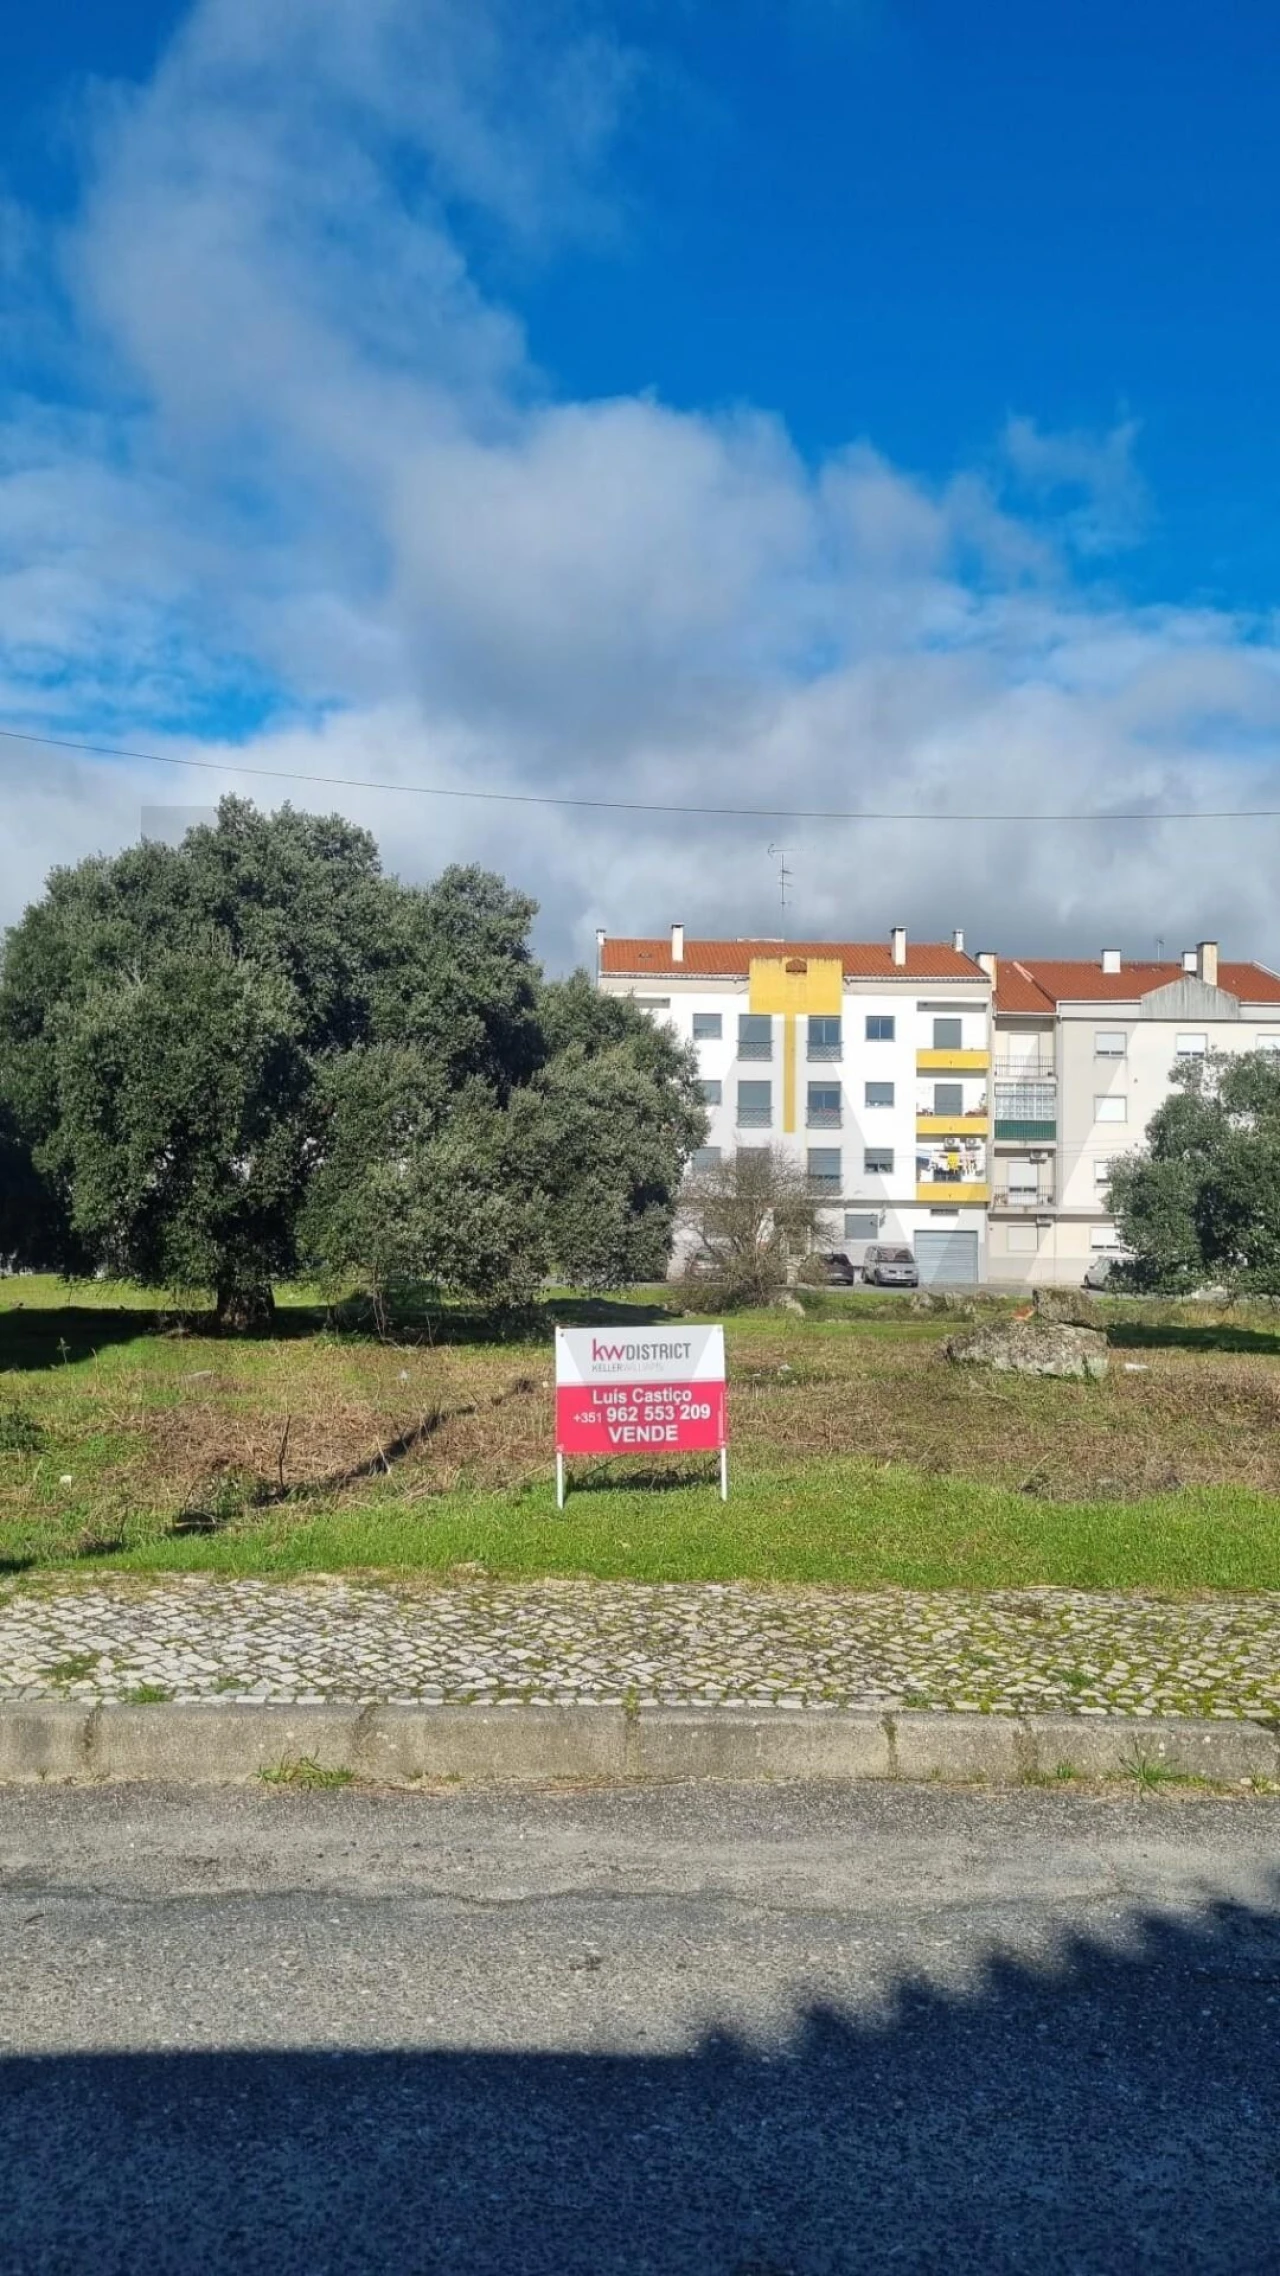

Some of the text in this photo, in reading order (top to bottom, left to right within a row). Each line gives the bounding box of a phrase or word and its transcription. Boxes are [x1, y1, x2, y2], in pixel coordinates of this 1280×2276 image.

[593, 1387, 692, 1405] Luís Castiço
[572, 1403, 711, 1424] +351 962 553 209
[608, 1424, 679, 1443] VENDE
